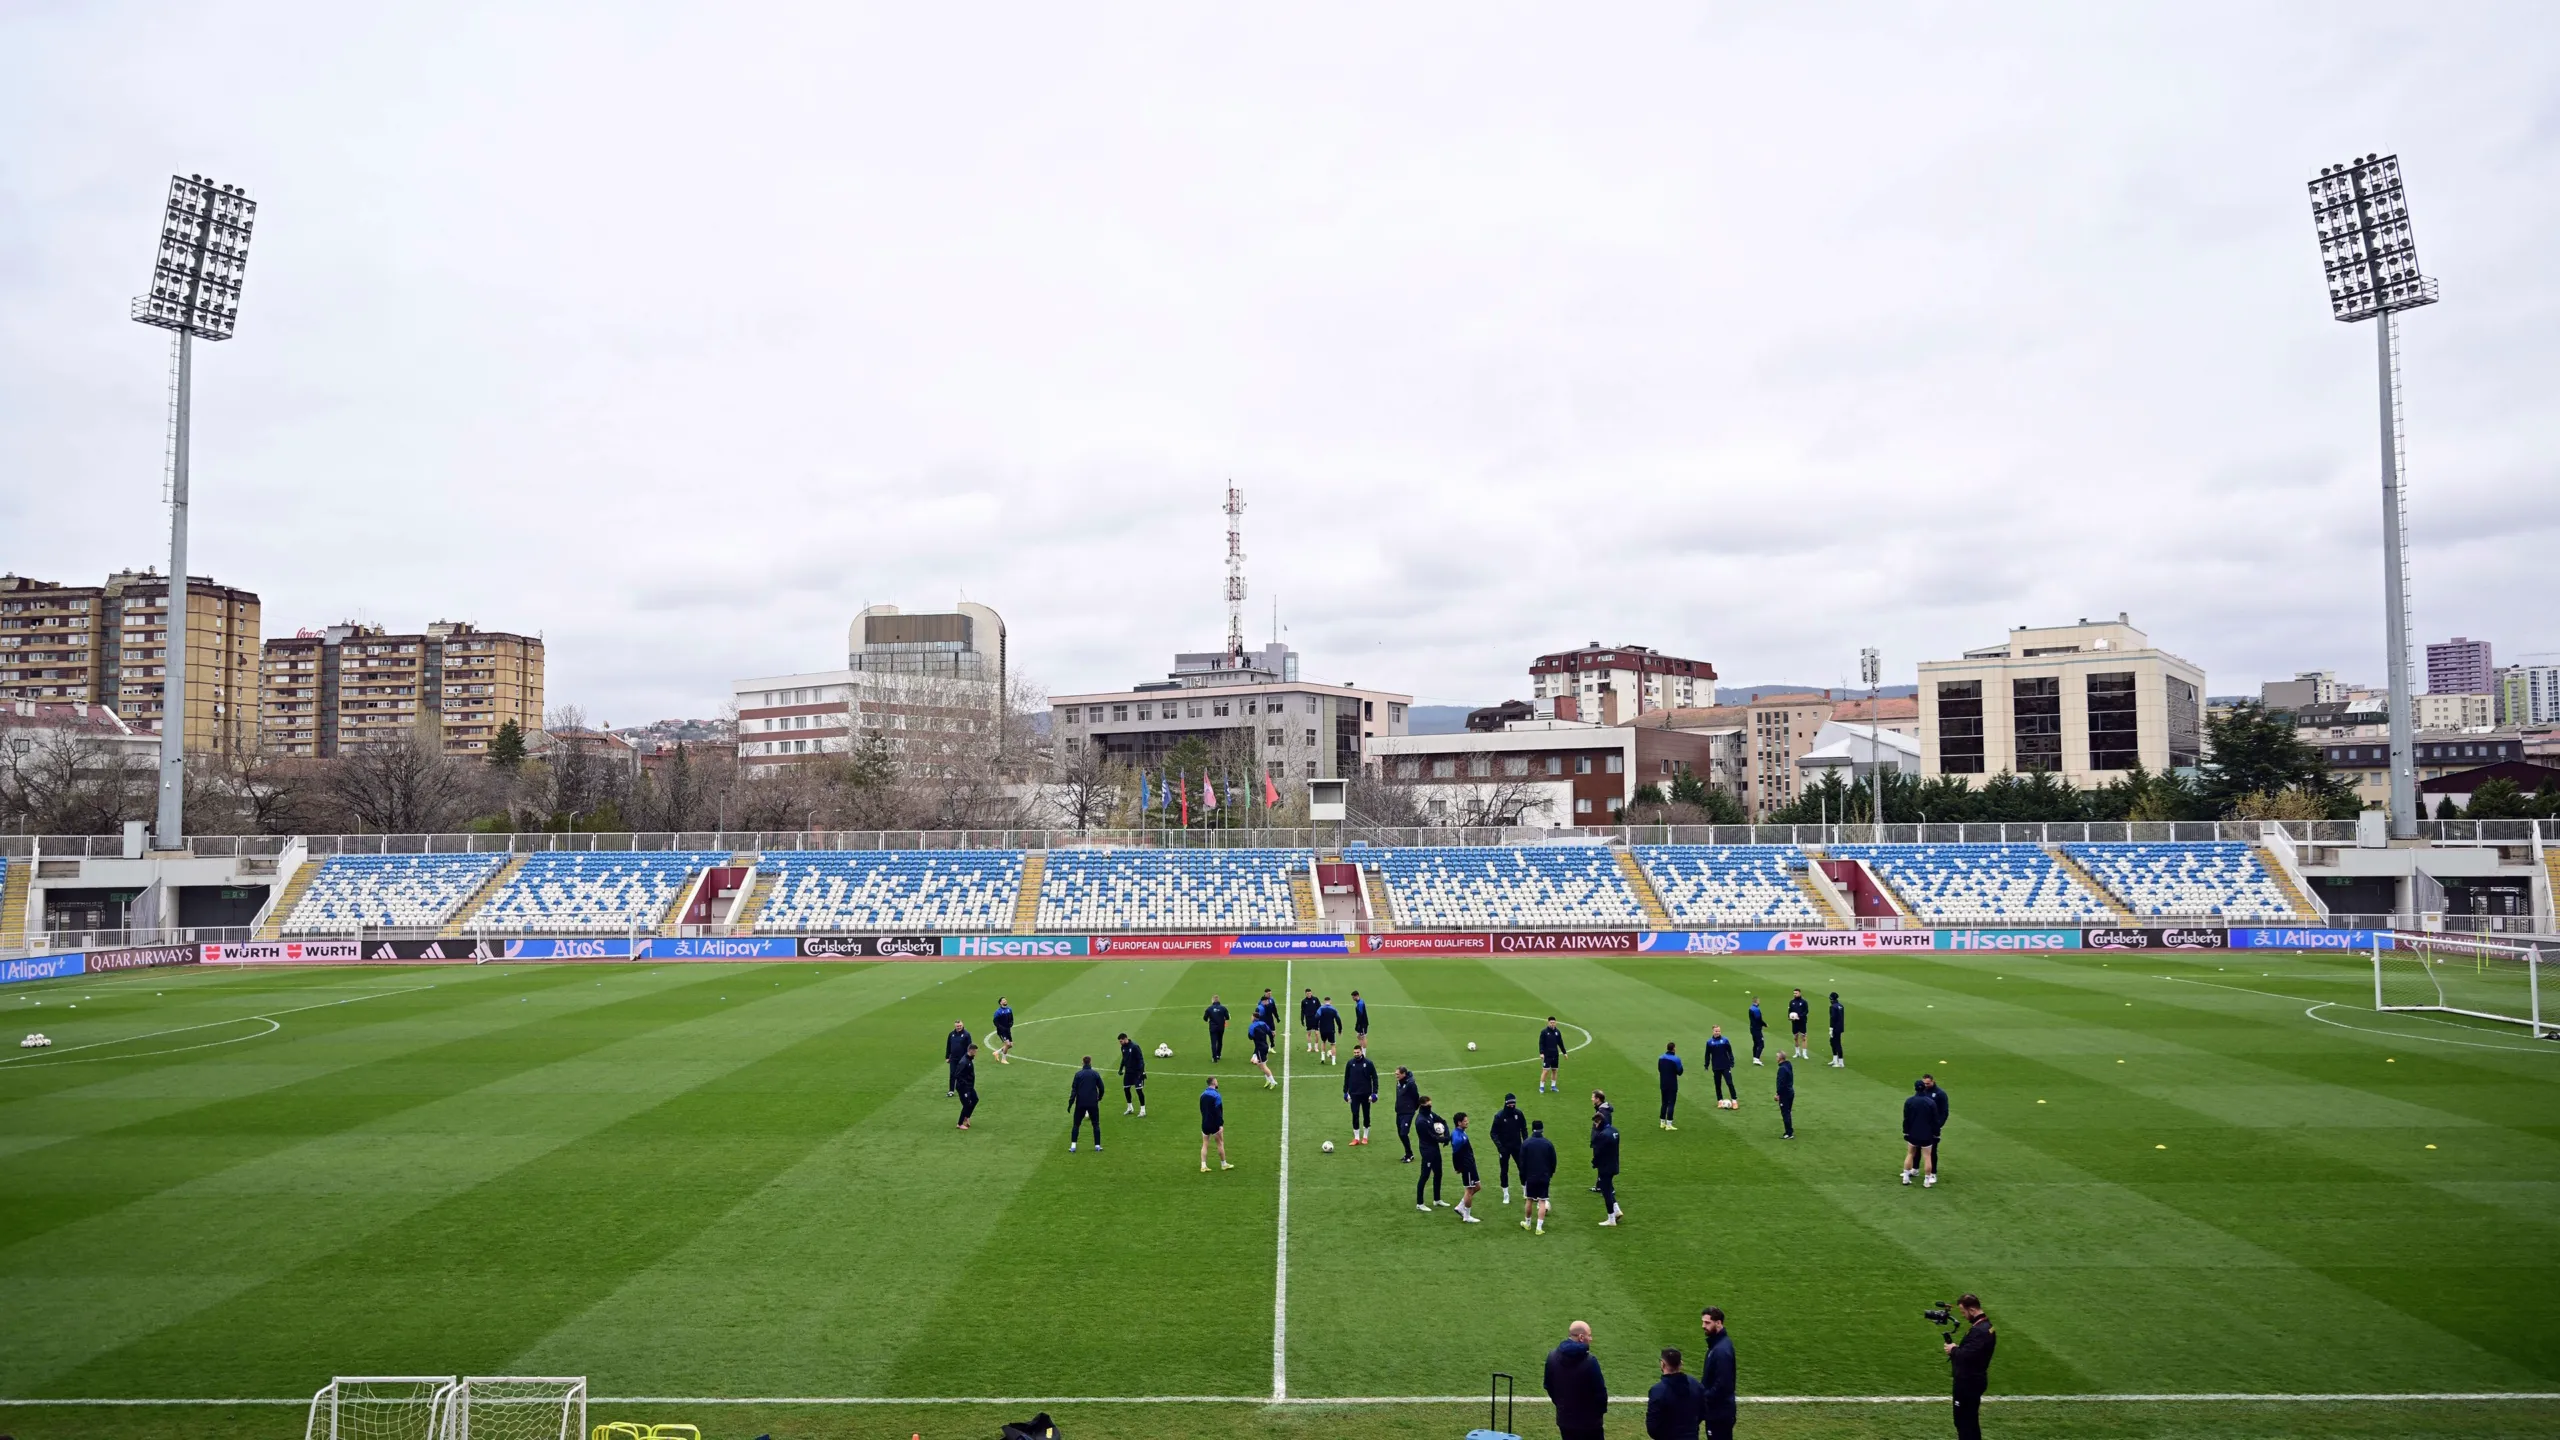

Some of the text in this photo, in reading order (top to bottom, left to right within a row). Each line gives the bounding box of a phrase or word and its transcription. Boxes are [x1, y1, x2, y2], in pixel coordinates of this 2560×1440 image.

[876, 937, 934, 956] Carlsberg
[959, 937, 1071, 956] Hisense
[1112, 941, 1212, 951] EUROPEAN QUALIFIERS
[1309, 940, 1355, 948] QUALIFIERS
[1384, 938, 1485, 948] EUROPEAN QUALIFIERS
[1501, 935, 1630, 951] QATAR AIRWAYS
[1806, 935, 1856, 946] WÜRTH
[1880, 935, 1930, 946] WÜRTH
[1950, 930, 2064, 949] Hisense
[2088, 929, 2148, 948] Carlsberg
[2162, 929, 2222, 948] Carlsberg
[305, 945, 357, 957] WÜRTH
[552, 940, 605, 957] Atos
[803, 938, 861, 957] Carlsberg
[91, 948, 193, 972] QATAR AIRWAYS
